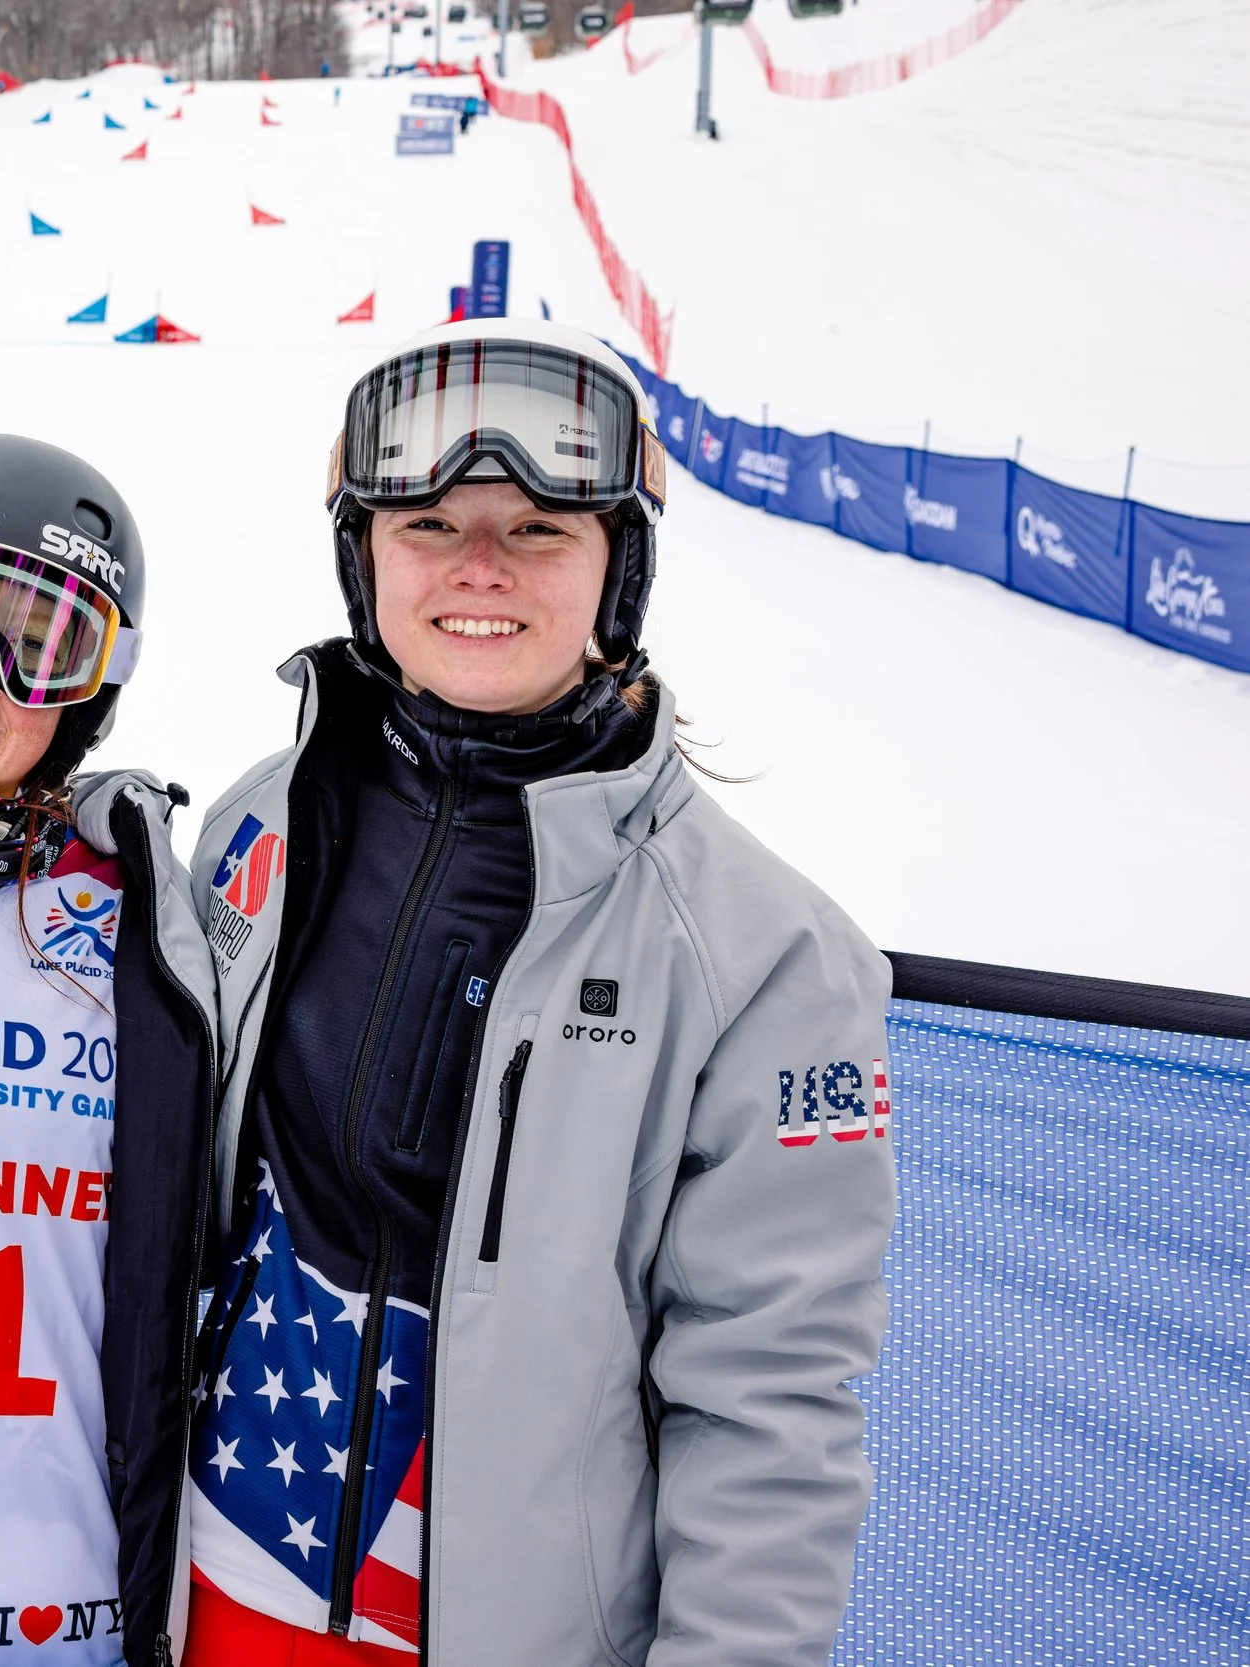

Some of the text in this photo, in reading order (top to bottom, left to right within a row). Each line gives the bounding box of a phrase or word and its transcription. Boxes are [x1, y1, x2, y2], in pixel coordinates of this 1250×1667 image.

[66, 961, 102, 978] PLACID
[104, 970, 115, 981] 20
[562, 1024, 636, 1045] ororo
[62, 1031, 117, 1083] 20
[62, 1598, 126, 1643] NY
